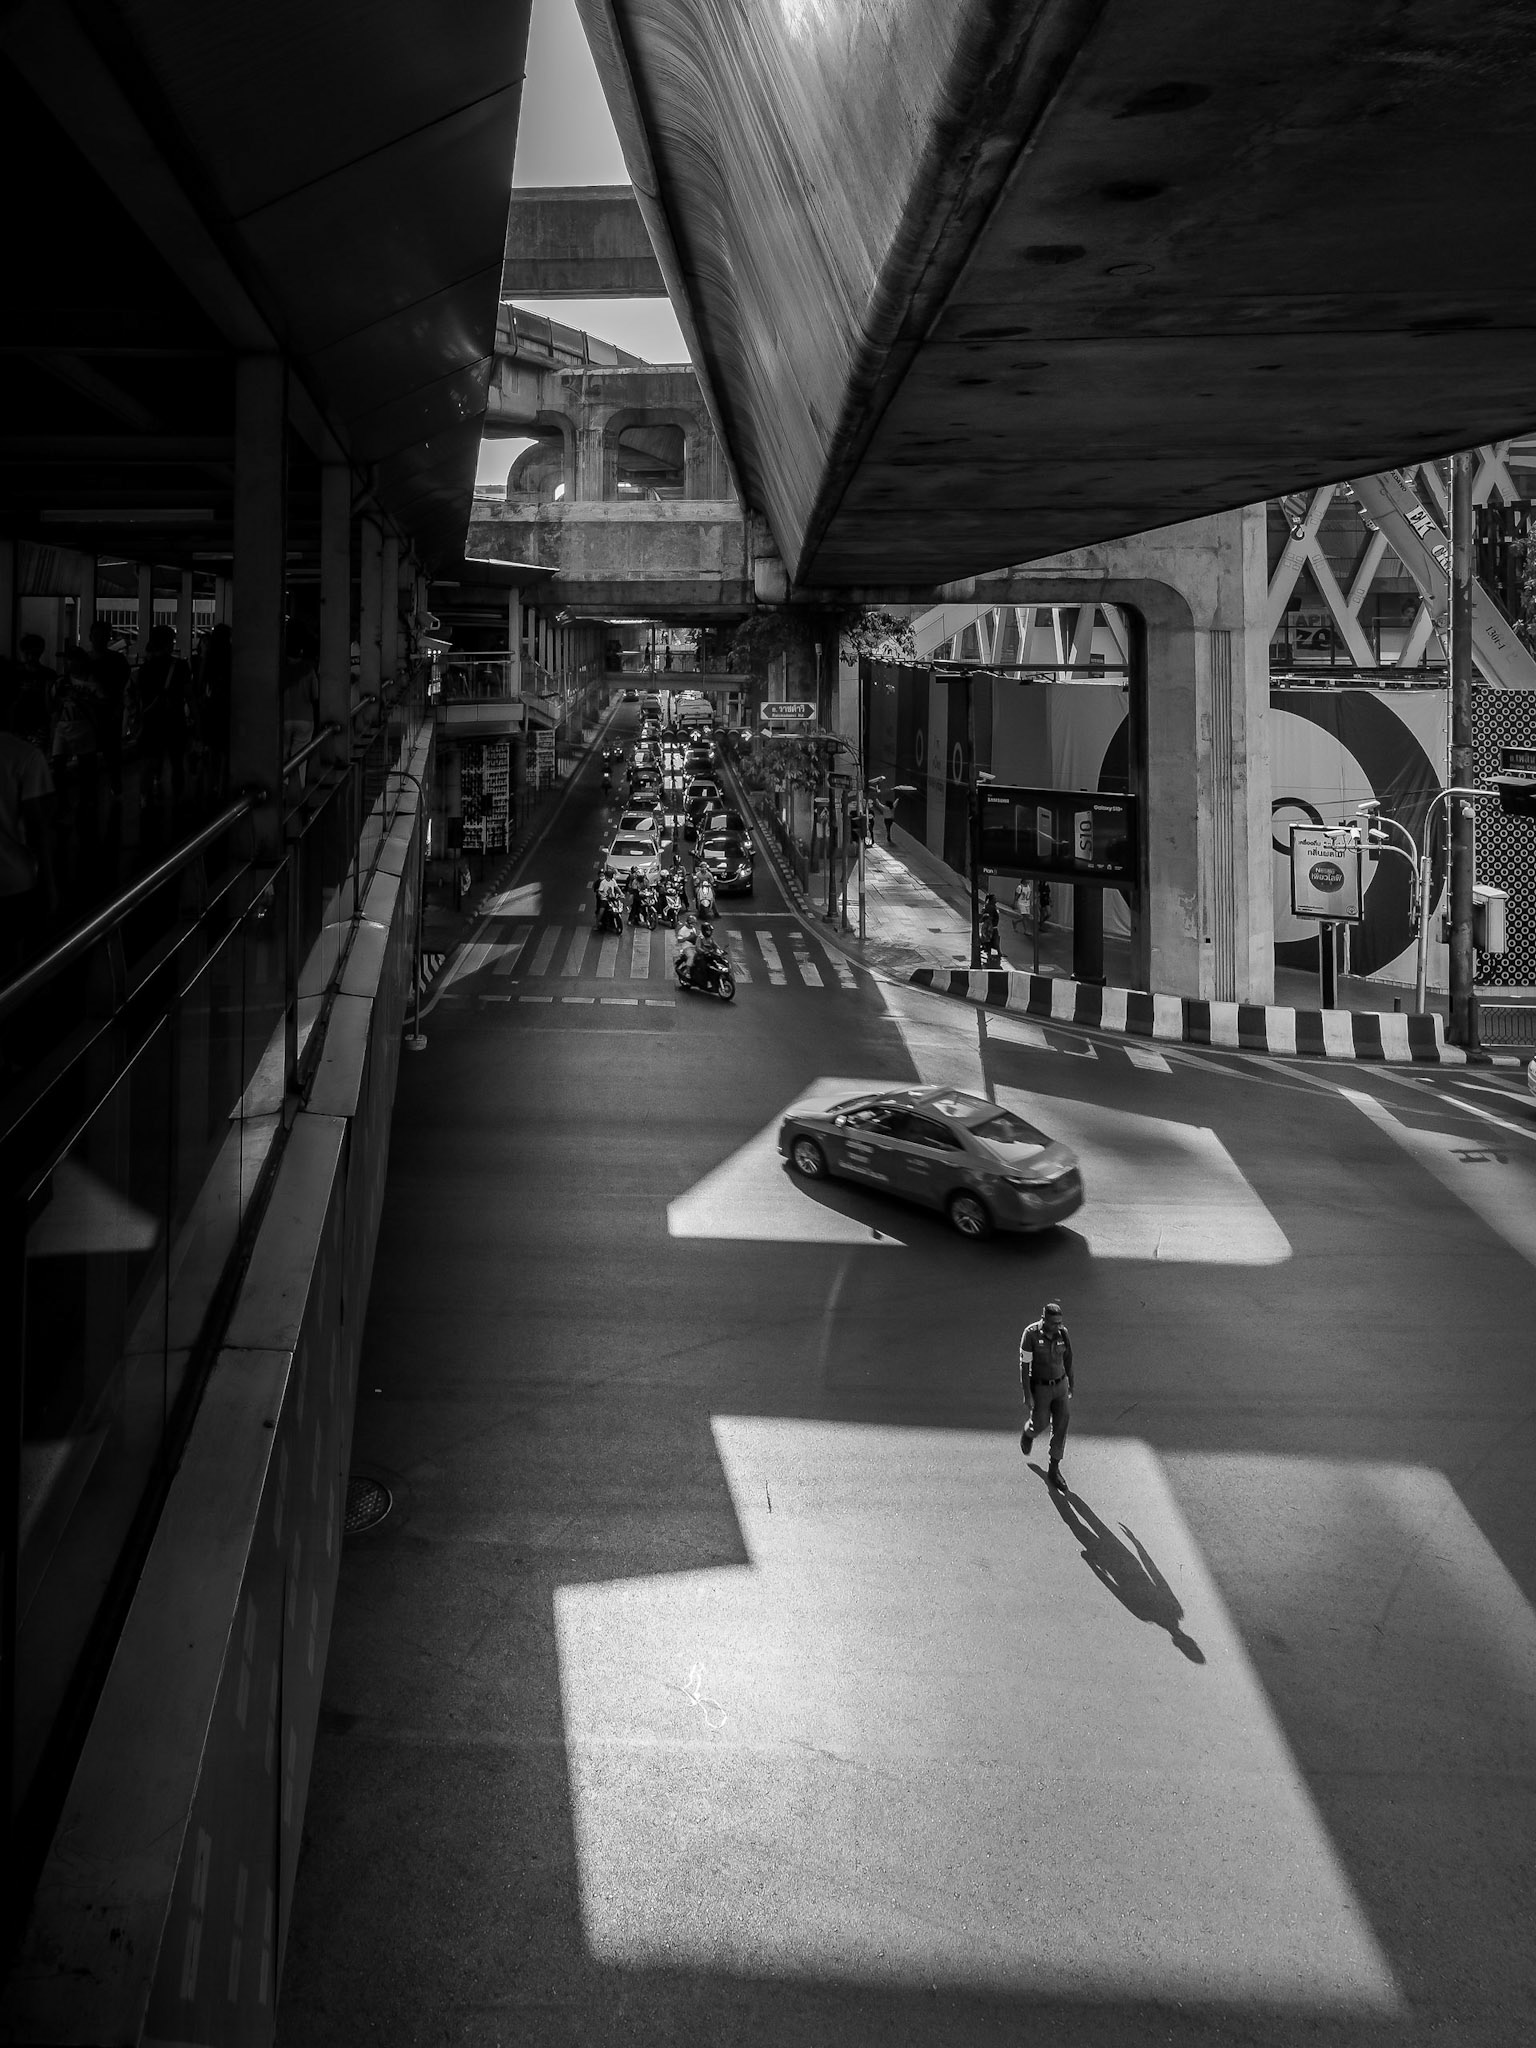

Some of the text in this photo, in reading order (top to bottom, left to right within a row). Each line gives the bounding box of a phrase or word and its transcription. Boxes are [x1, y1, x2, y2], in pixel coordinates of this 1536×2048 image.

[1390, 470, 1407, 492] ADANO
[1404, 504, 1453, 574] EK CR
[1093, 804, 1113, 812] Galaxy
[1079, 820, 1092, 852] S10
